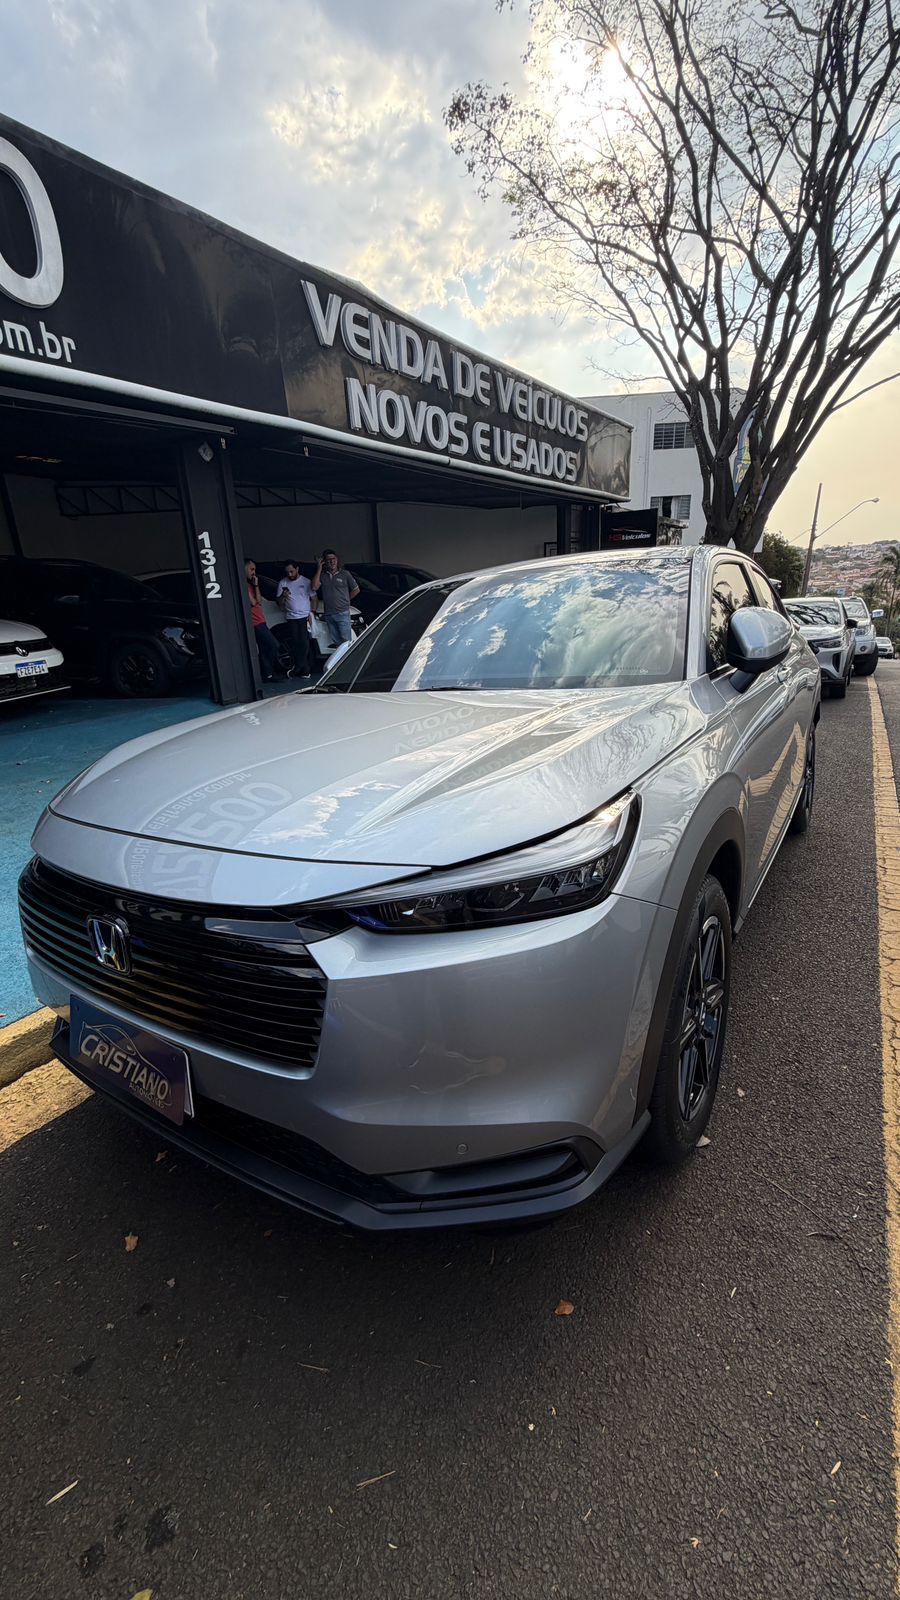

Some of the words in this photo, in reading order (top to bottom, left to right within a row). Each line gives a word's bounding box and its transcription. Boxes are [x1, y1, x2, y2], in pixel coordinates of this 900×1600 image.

[0, 320, 77, 363] m.br
[300, 279, 449, 391] VENDA
[452, 350, 491, 407] DE
[494, 370, 589, 442] VEÍCULOS
[345, 376, 469, 456] NOVOS
[472, 421, 491, 462] E
[493, 425, 578, 482] USADOS
[198, 531, 222, 599] 1312
[80, 1034, 169, 1100] CRISTIANO
